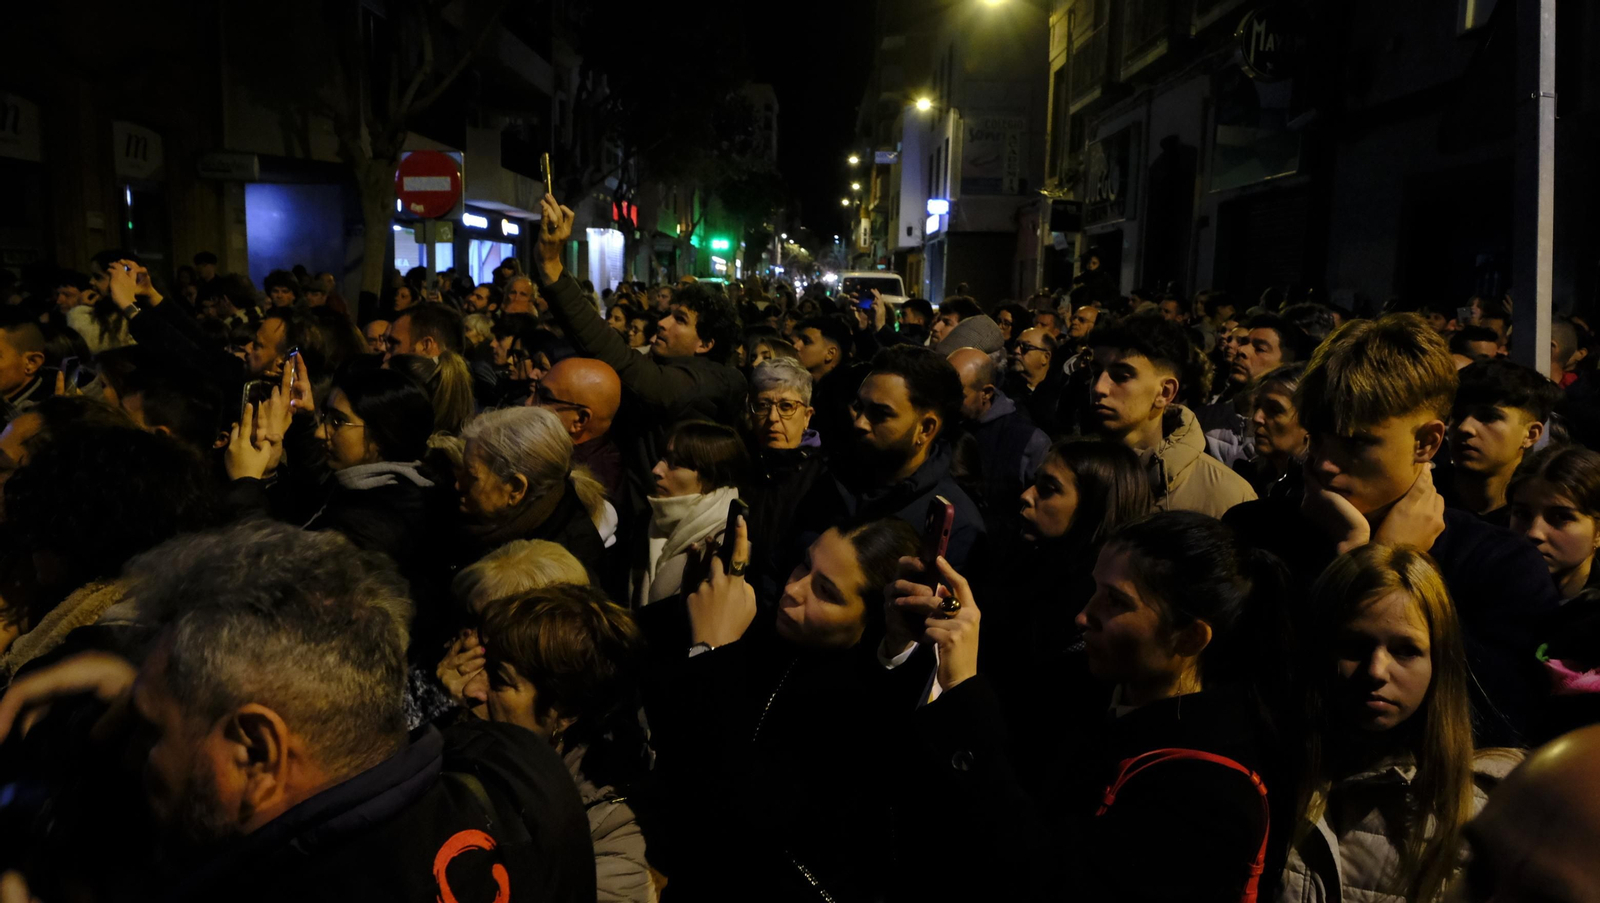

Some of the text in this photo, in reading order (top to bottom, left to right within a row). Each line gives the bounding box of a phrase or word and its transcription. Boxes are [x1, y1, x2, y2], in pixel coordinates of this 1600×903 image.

[985, 119, 1024, 130] COLEGIO
[125, 132, 148, 162] m
[1008, 133, 1018, 193] ACADEMIA
